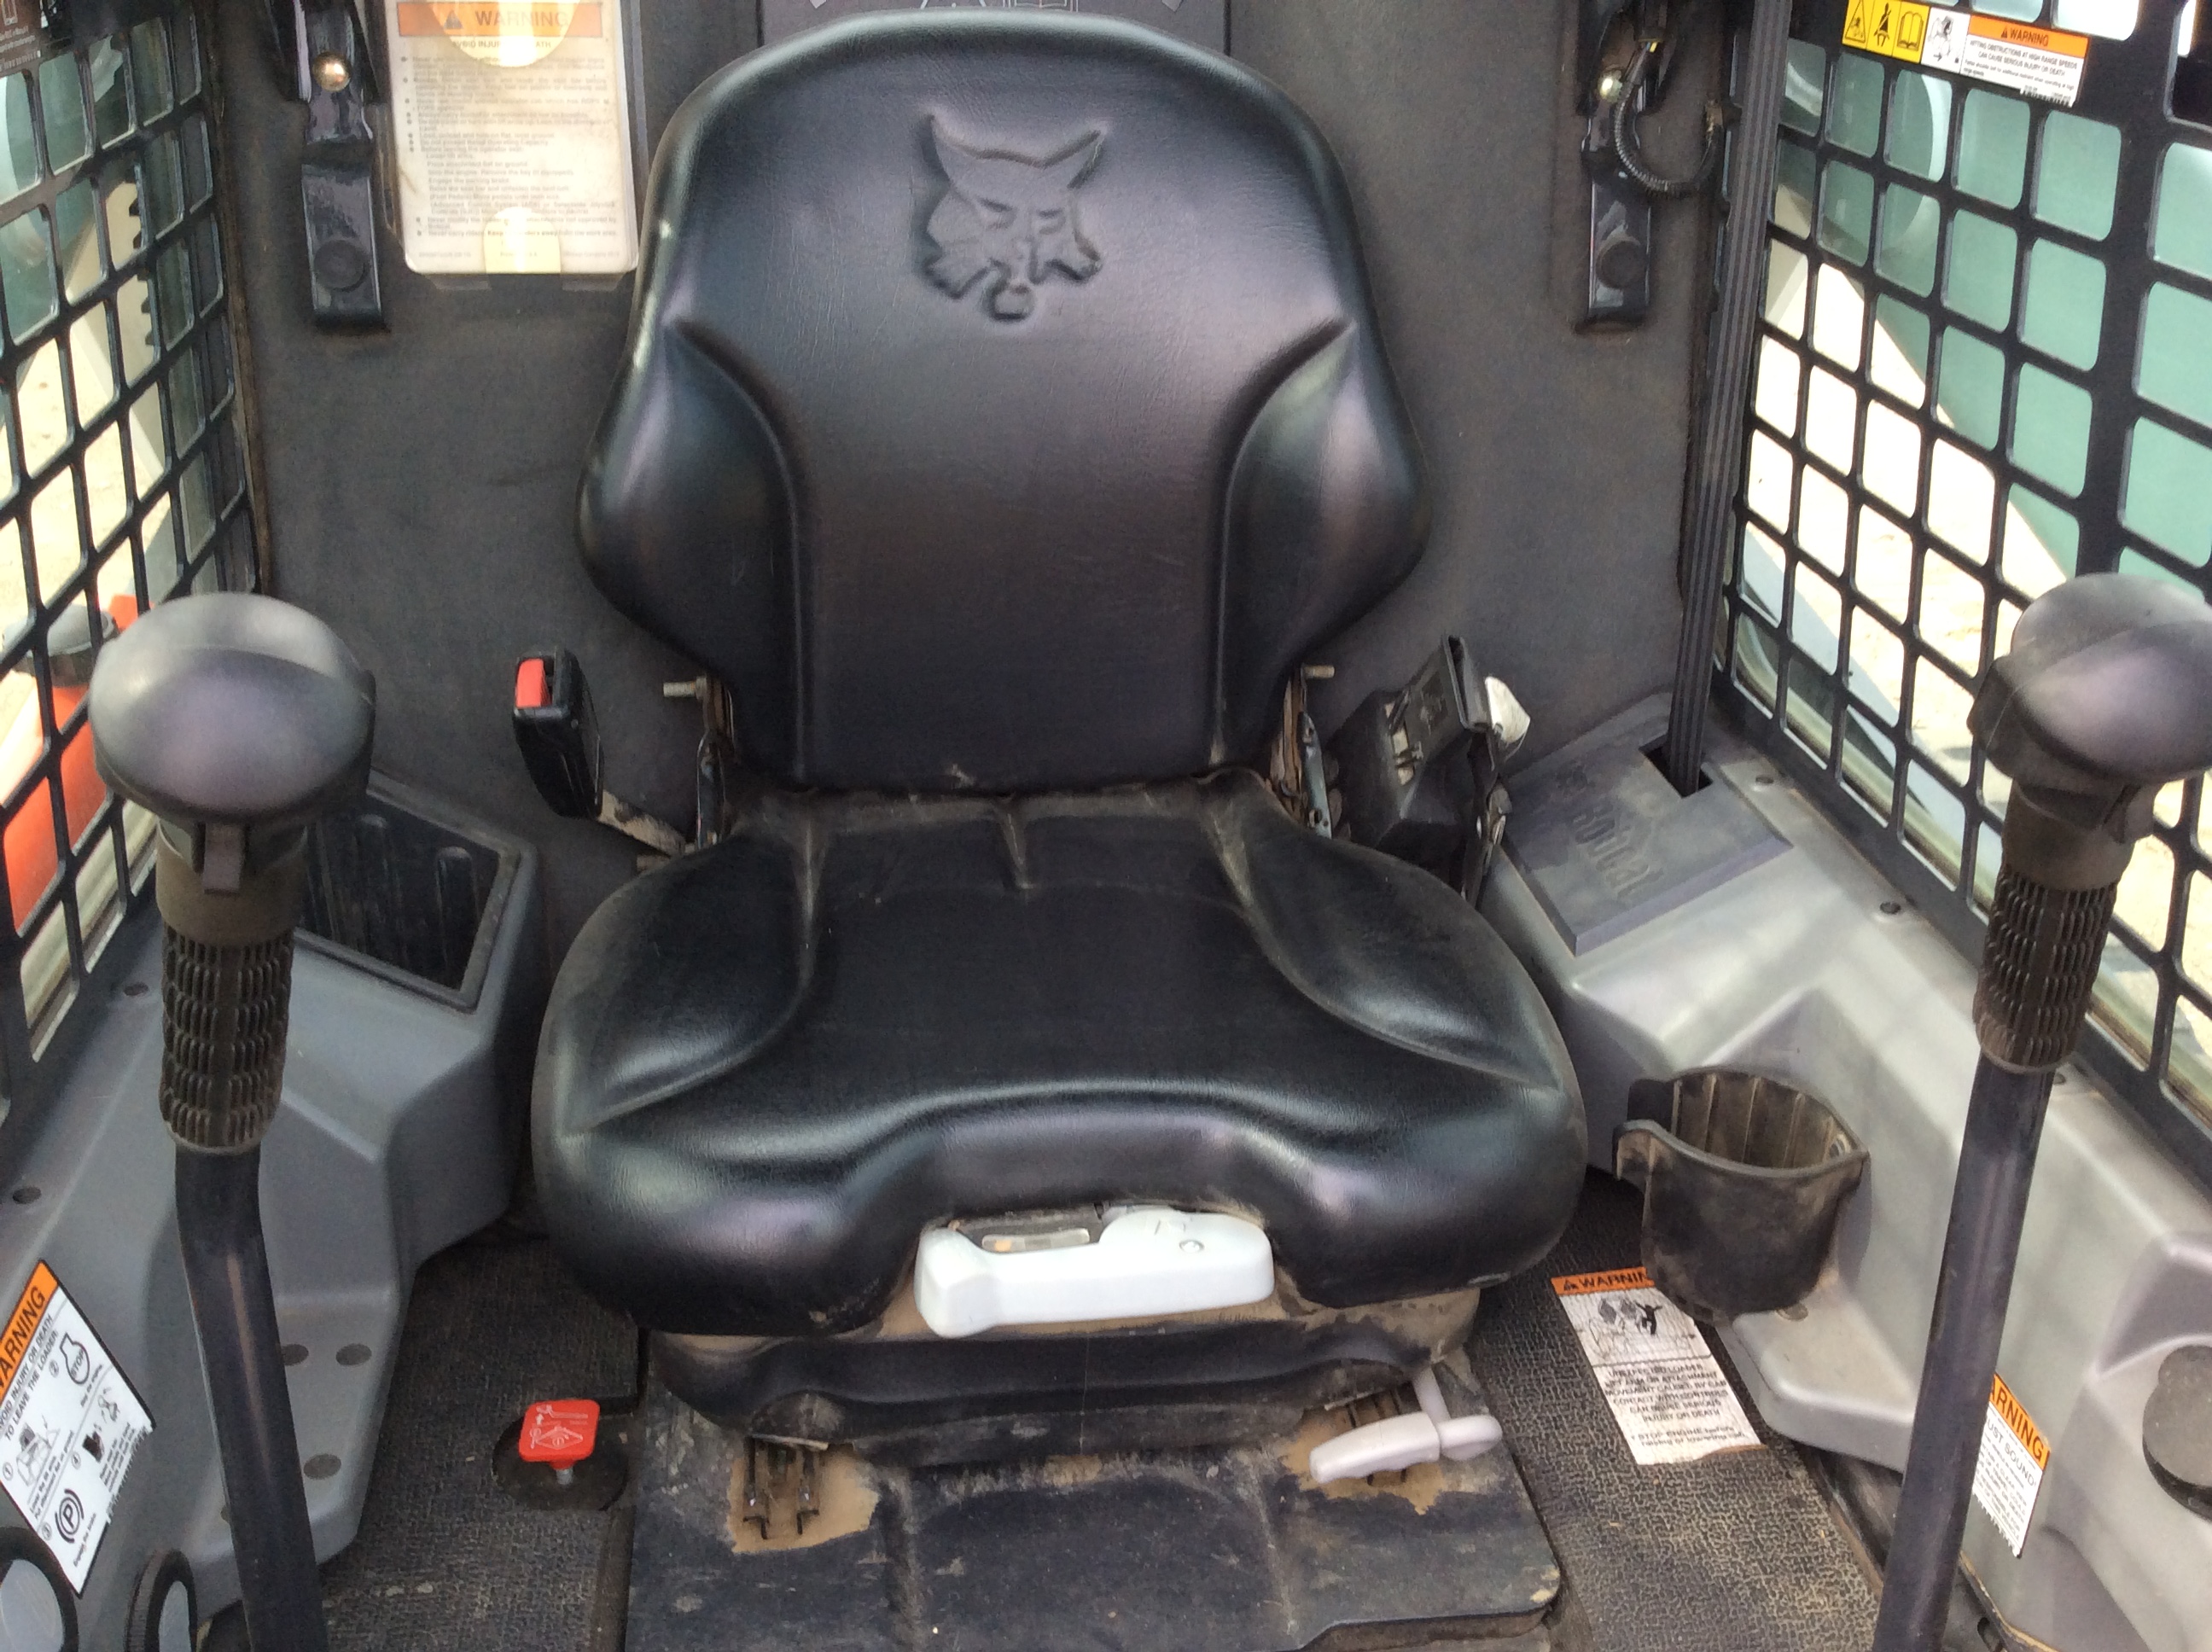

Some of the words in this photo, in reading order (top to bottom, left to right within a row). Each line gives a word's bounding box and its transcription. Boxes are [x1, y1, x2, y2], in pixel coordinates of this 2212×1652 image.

[475, 11, 568, 26] WARNING
[2011, 26, 2049, 47] WARNING
[0, 1285, 45, 1388] ARNING
[0, 1400, 13, 1430] VOID
[11, 1362, 29, 1400] INJURY
[28, 1346, 38, 1364] OR
[36, 1313, 53, 1348] DEATH
[70, 1348, 84, 1377] STOP
[5, 1424, 15, 1441] TO
[13, 1391, 30, 1425] LEAVE
[28, 1369, 40, 1391] THE
[1992, 1377, 2044, 1462] RNING
[1987, 1418, 2004, 1444] UST
[63, 1504, 74, 1529] P
